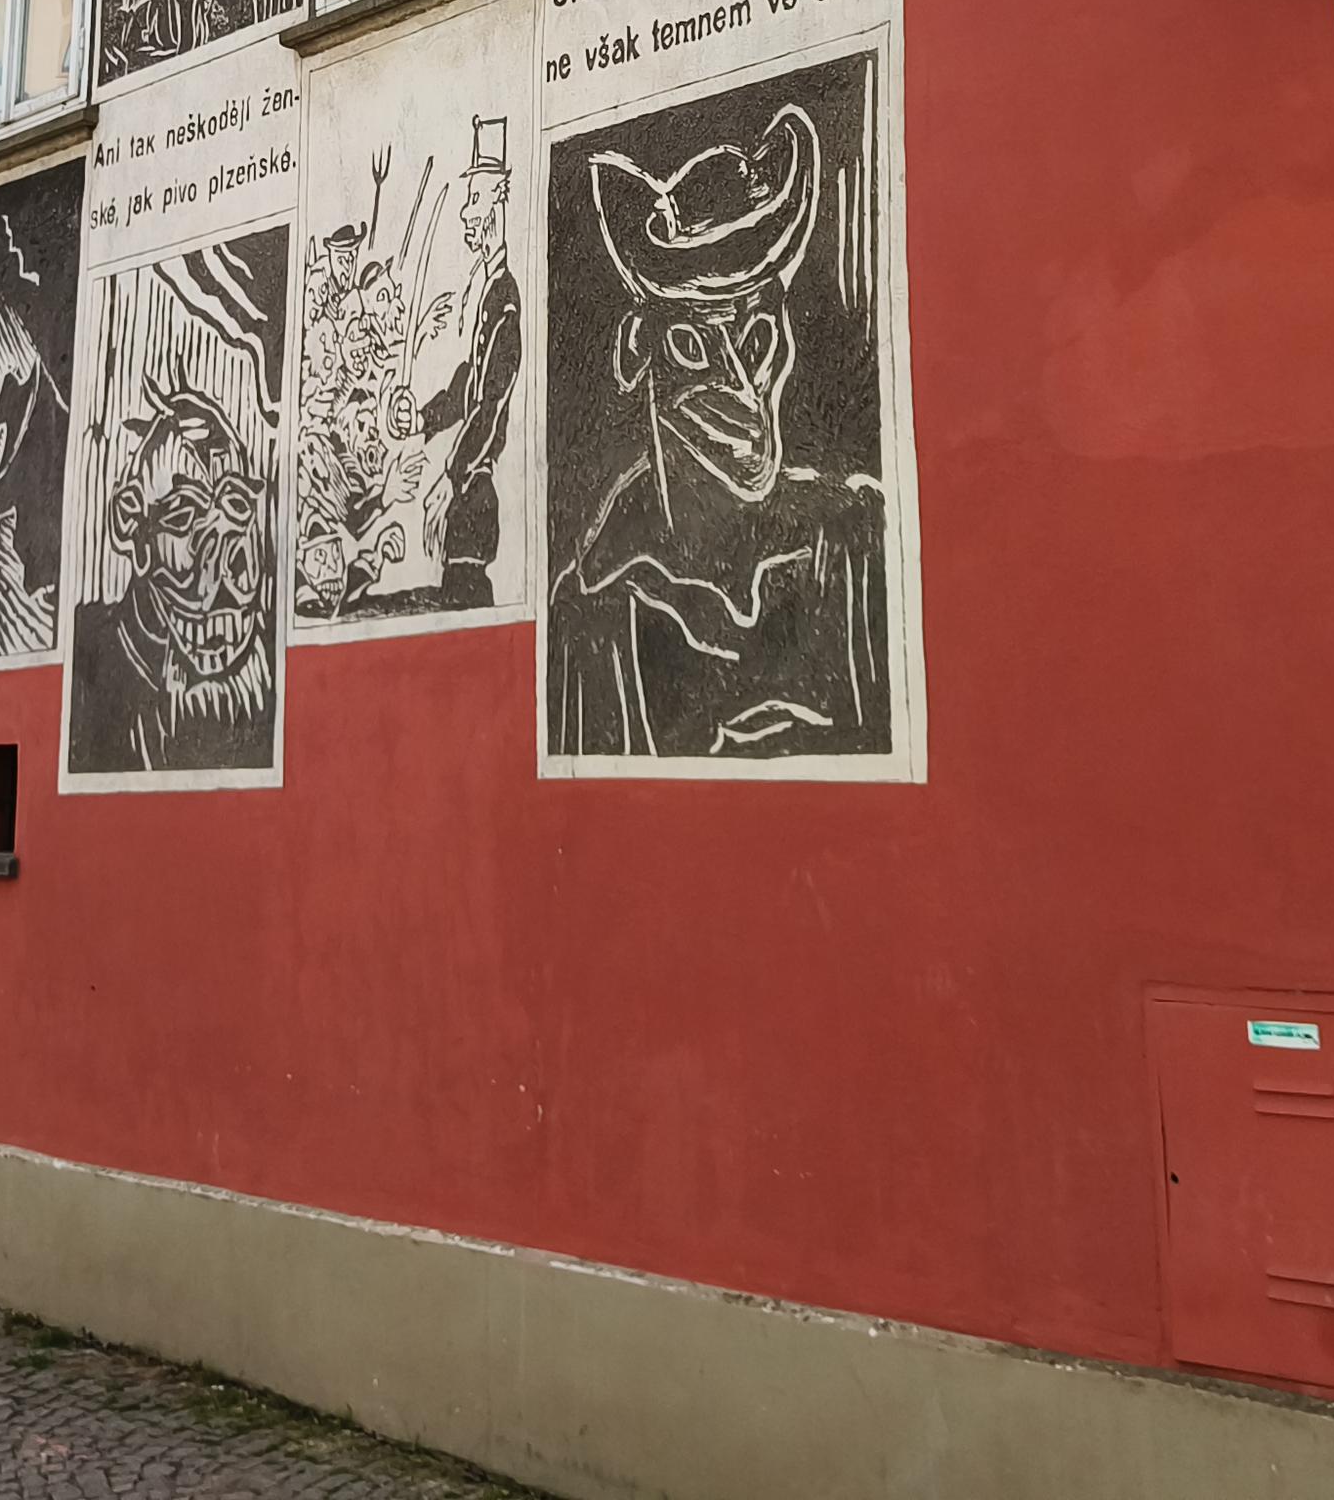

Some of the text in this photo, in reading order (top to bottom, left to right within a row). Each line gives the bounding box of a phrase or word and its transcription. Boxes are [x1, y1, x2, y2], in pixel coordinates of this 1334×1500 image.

[546, 53, 570, 83] ne
[585, 26, 640, 71] však
[94, 88, 299, 169] Ani tak neškodějí žen-
[90, 143, 296, 229] ské, jak pivo plzeňské.
